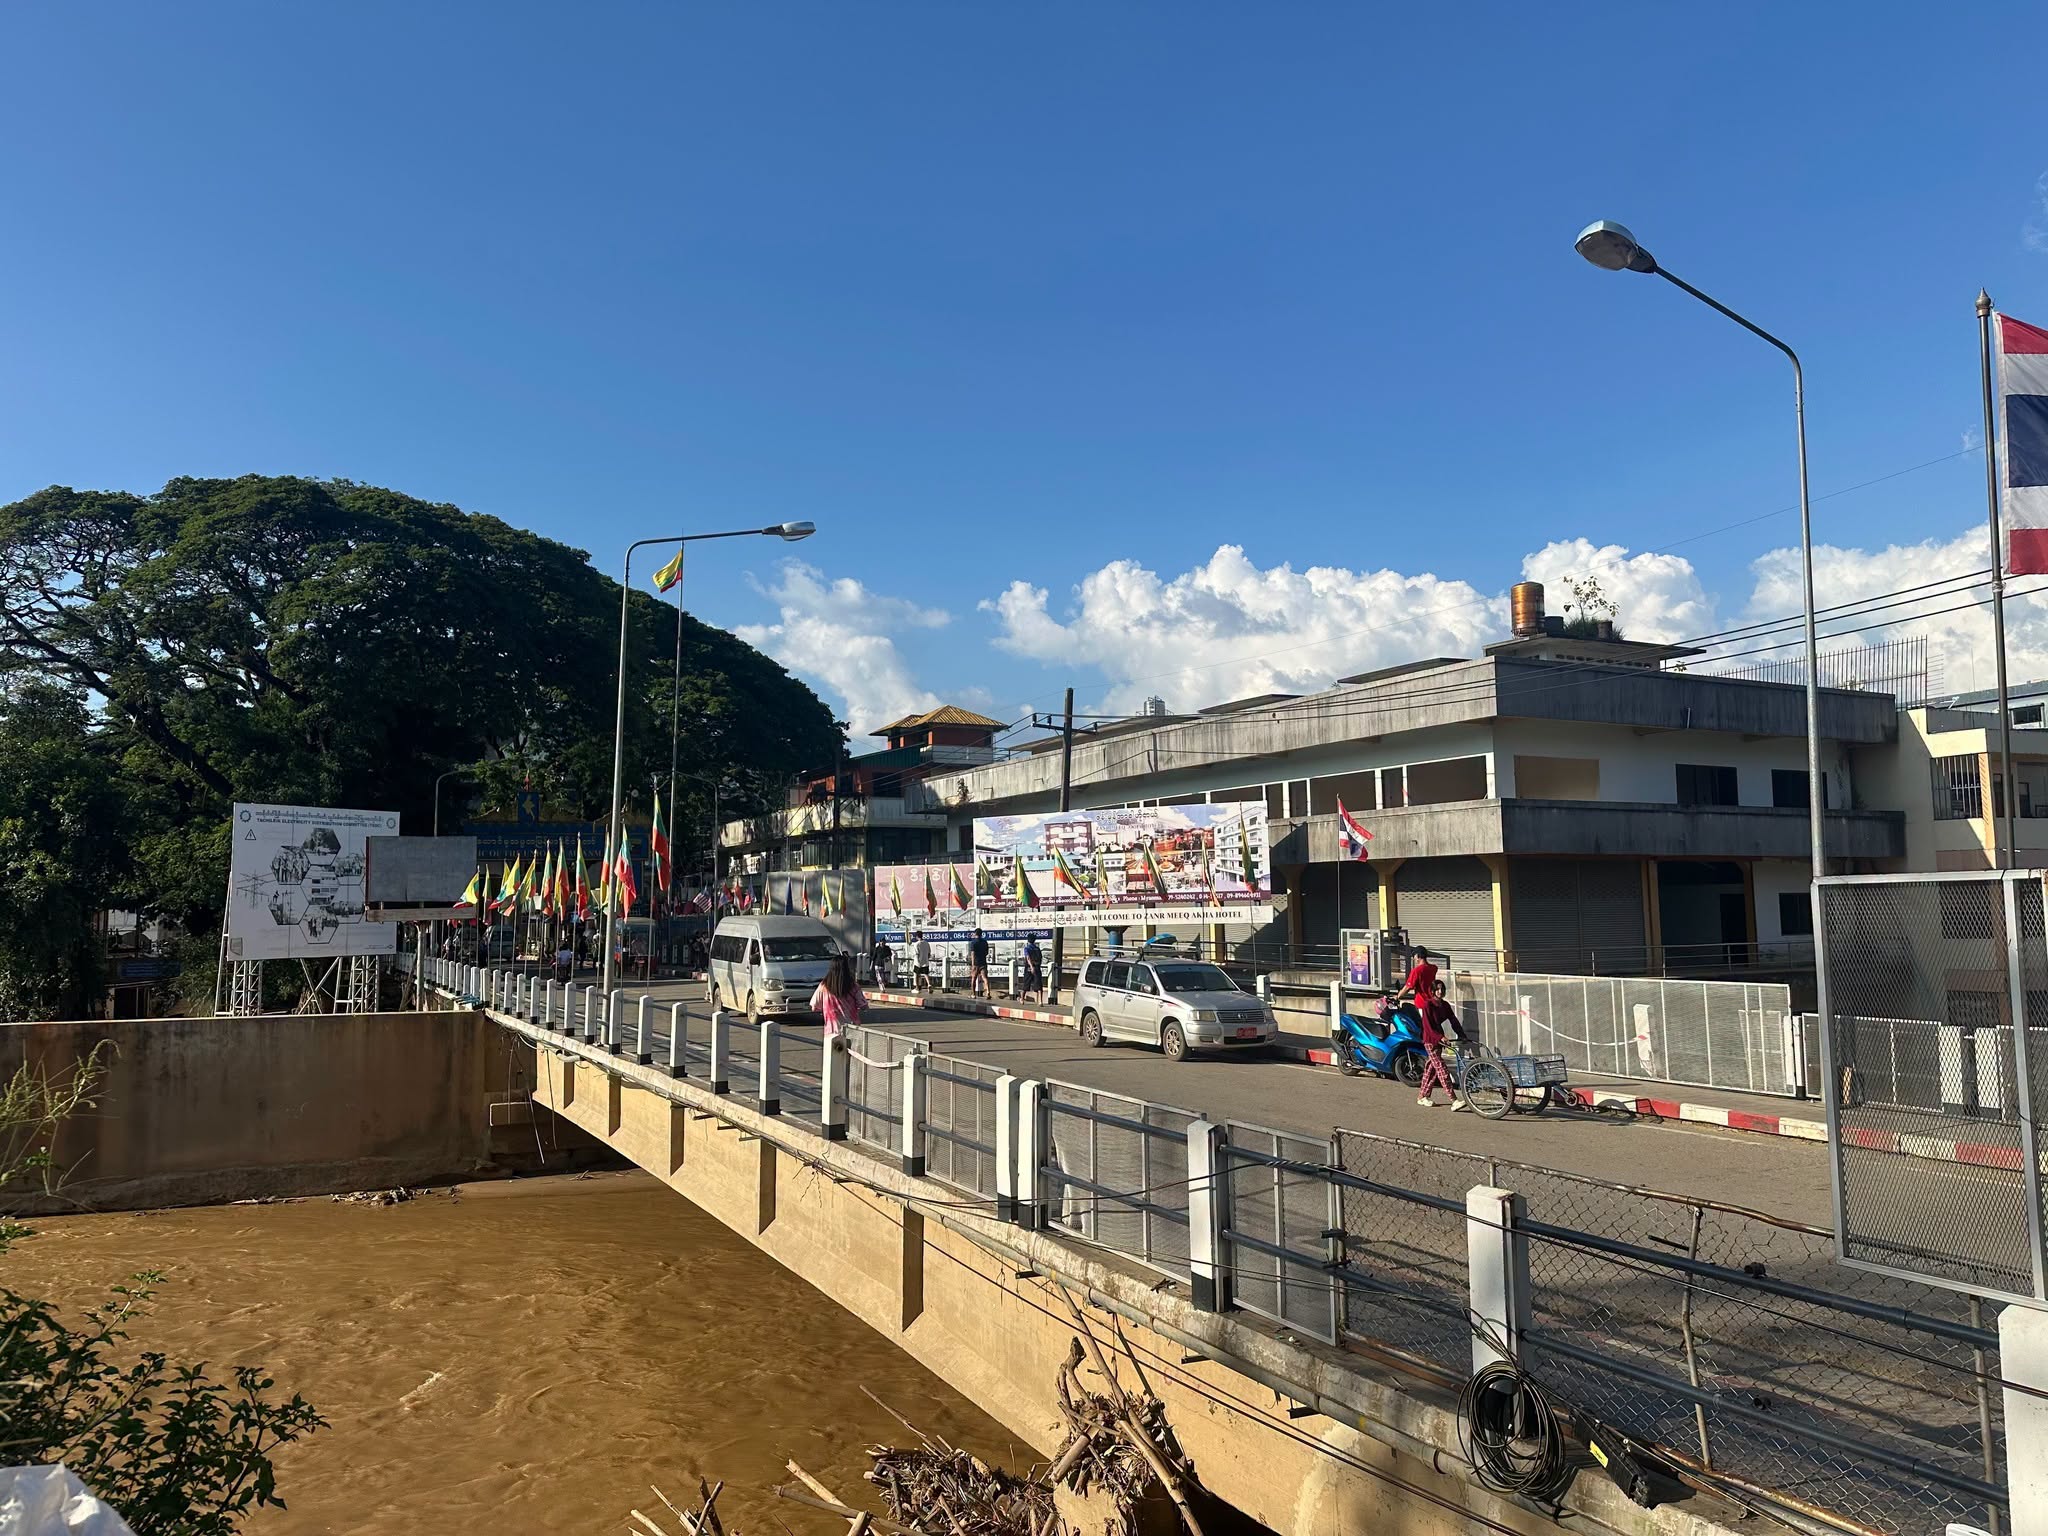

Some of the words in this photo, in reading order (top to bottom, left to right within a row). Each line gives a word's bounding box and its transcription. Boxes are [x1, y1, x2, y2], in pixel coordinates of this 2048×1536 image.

[1092, 913, 1129, 921] WELCOME
[1132, 912, 1142, 920] TO
[1167, 911, 1190, 919] MEEQ
[1192, 911, 1214, 919] AKHA
